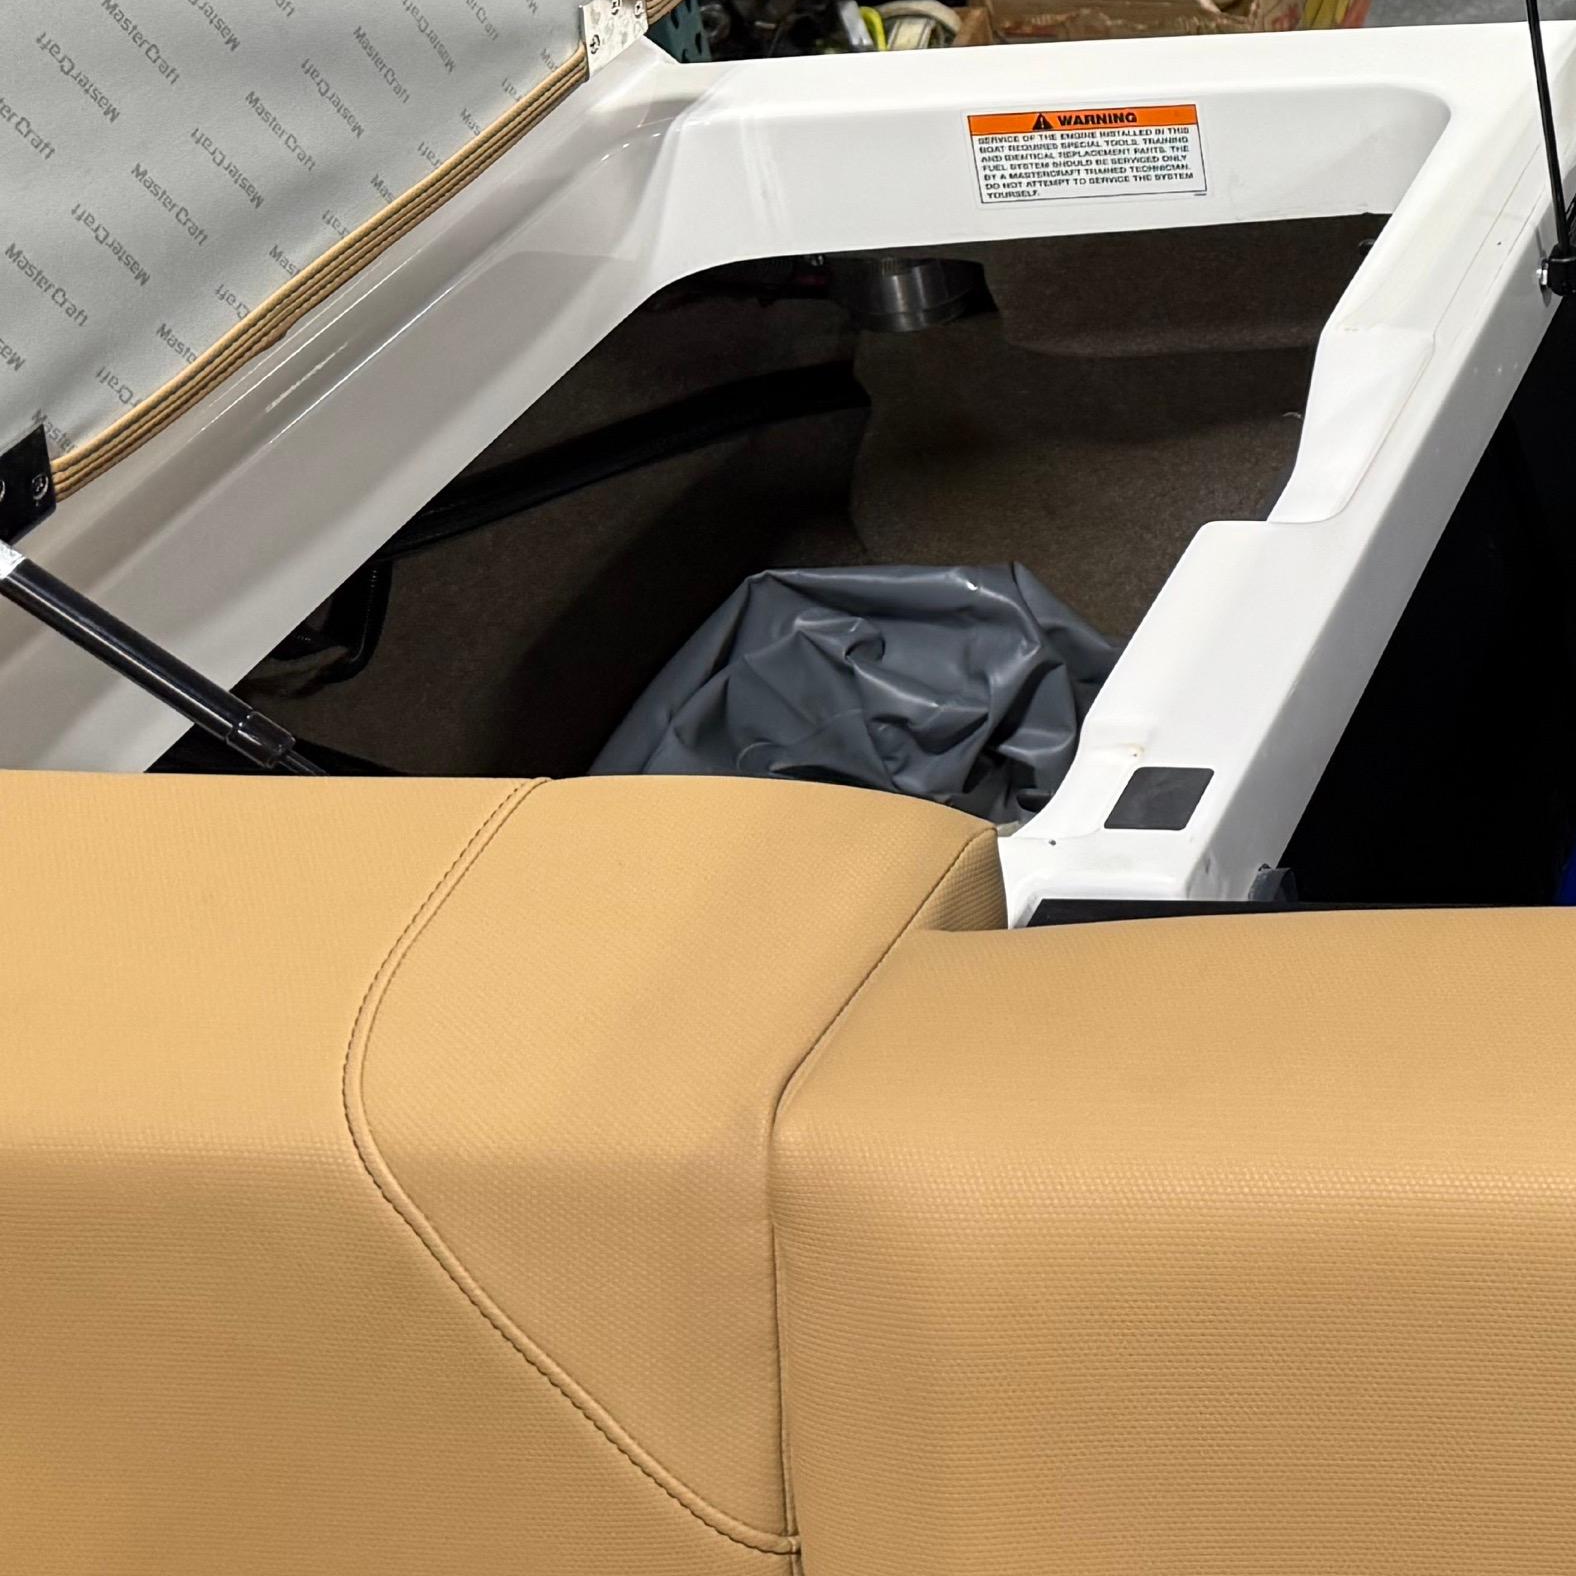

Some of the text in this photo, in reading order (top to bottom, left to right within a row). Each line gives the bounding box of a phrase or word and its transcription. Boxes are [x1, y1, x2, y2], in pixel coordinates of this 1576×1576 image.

[34, 30, 122, 125] MasterCraft
[1058, 112, 1137, 126] WARNING
[1099, 129, 1151, 137] INSTALLED
[979, 145, 1004, 153] BOAT
[1008, 143, 1057, 151] REQUIRES
[1060, 140, 1100, 149] SPECIAL
[1142, 136, 1188, 144] TRAINING
[1004, 152, 1054, 161] IDENTICAL
[1058, 148, 1130, 158] REPLACEMENT
[1009, 162, 1049, 170] SYSTEM
[1052, 159, 1092, 167] SHOULD
[1110, 156, 1159, 164] SERVICED
[1009, 169, 1081, 179] MASTERCRAFT
[1084, 167, 1126, 175] TRAINED
[1025, 179, 1070, 187] ATTEMPT
[1088, 175, 1129, 184] SERVICE
[1154, 172, 1193, 180] SYSTEM
[3, 241, 90, 328] MasterCraft
